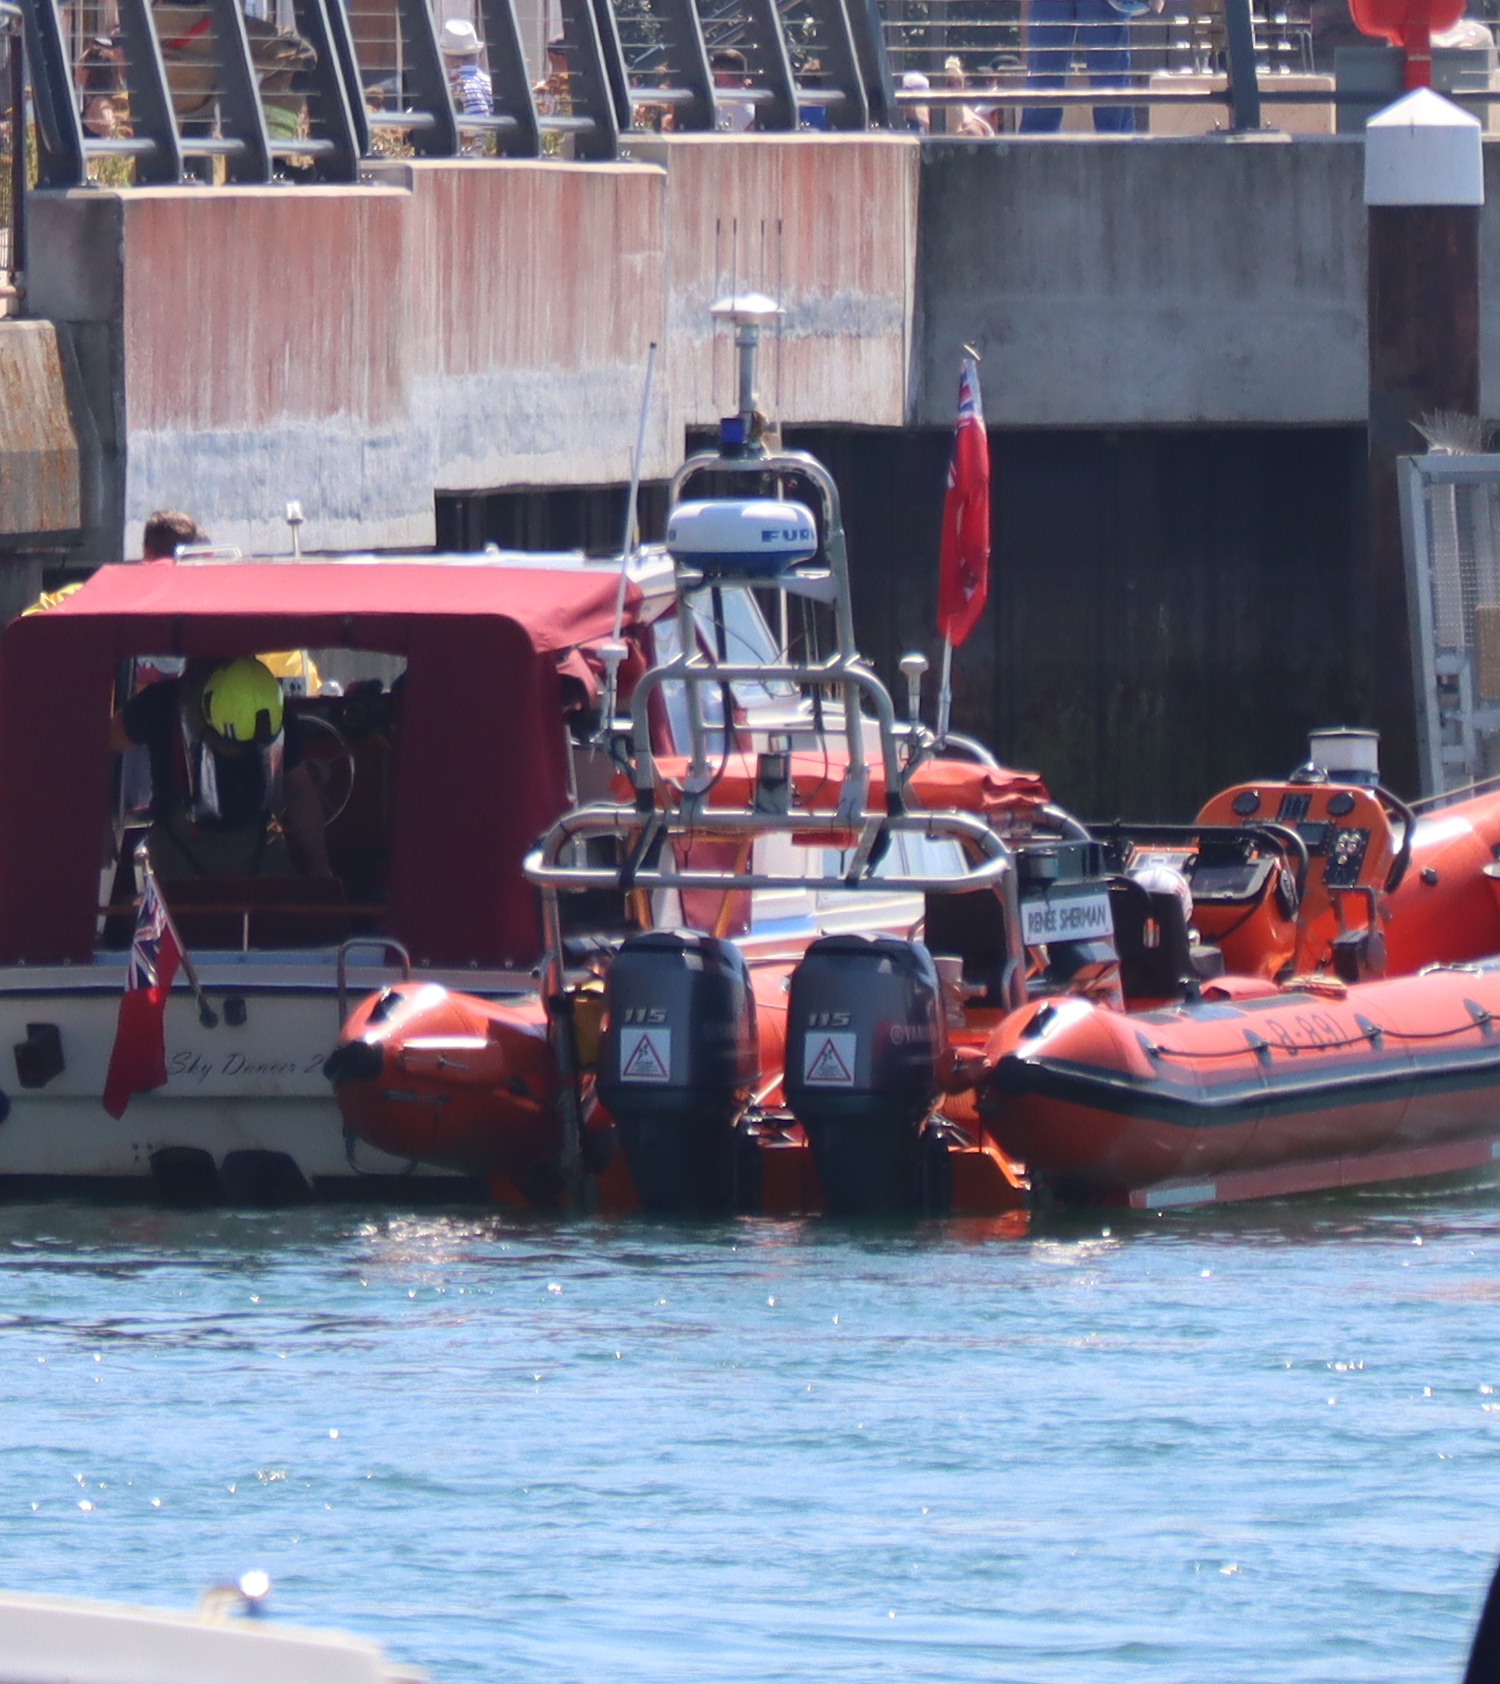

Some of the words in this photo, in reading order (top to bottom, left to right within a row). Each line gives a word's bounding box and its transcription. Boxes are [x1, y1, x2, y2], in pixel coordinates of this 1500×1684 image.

[1059, 904, 1107, 930] SHERMAN
[624, 1008, 666, 1023] 115
[808, 1011, 850, 1026] 115
[167, 1050, 212, 1085] Sky
[221, 1052, 297, 1076] Dancer
